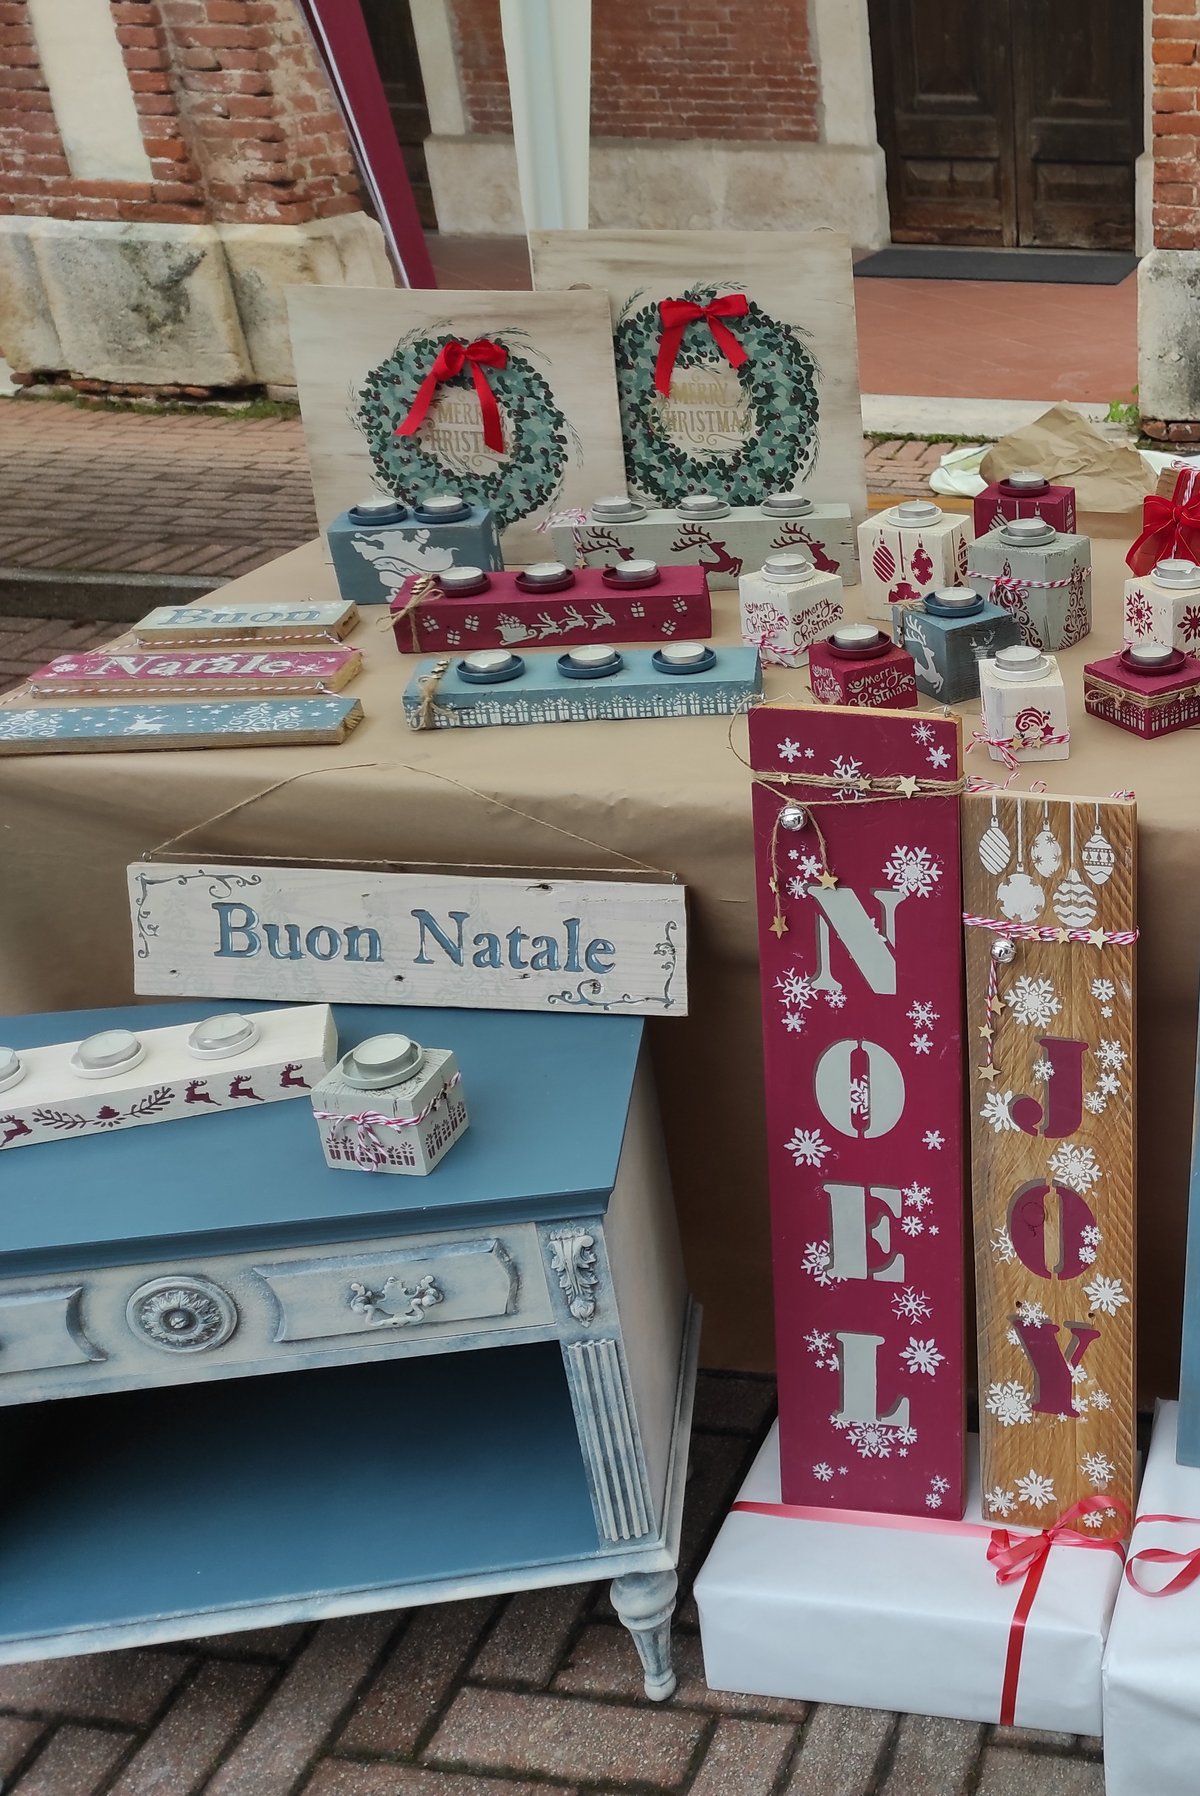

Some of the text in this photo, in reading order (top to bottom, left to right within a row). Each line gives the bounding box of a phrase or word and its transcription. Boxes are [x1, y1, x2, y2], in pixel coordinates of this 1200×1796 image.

[157, 608, 322, 626] Buon
[85, 654, 294, 676] Natale
[212, 901, 385, 964] Buon
[410, 907, 618, 974] Natale
[1008, 1035, 1102, 1419] JOY
